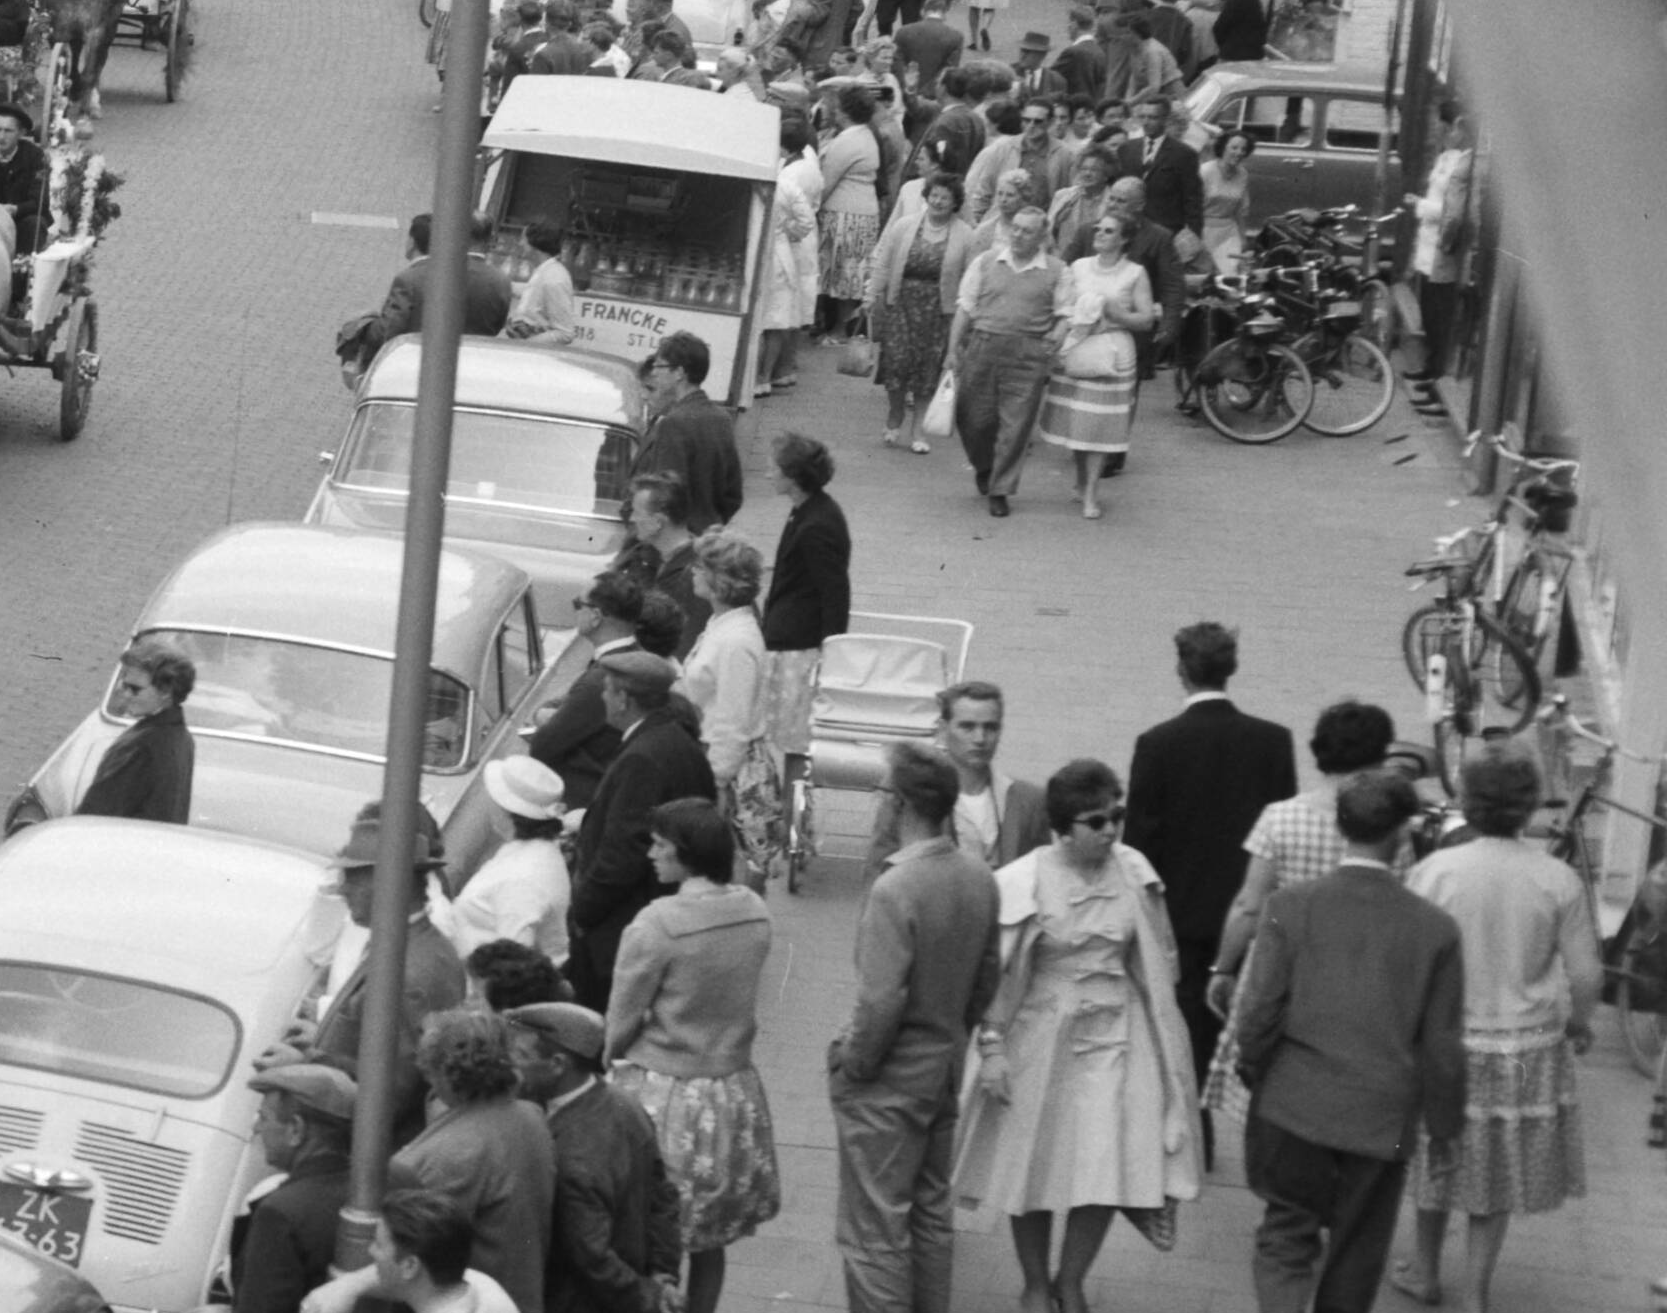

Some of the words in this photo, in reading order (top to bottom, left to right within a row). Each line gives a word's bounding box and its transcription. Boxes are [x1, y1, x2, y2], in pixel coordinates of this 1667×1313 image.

[581, 302, 668, 335] FRANCKE
[627, 333, 645, 348] ST
[15, 1189, 63, 1225] ZK
